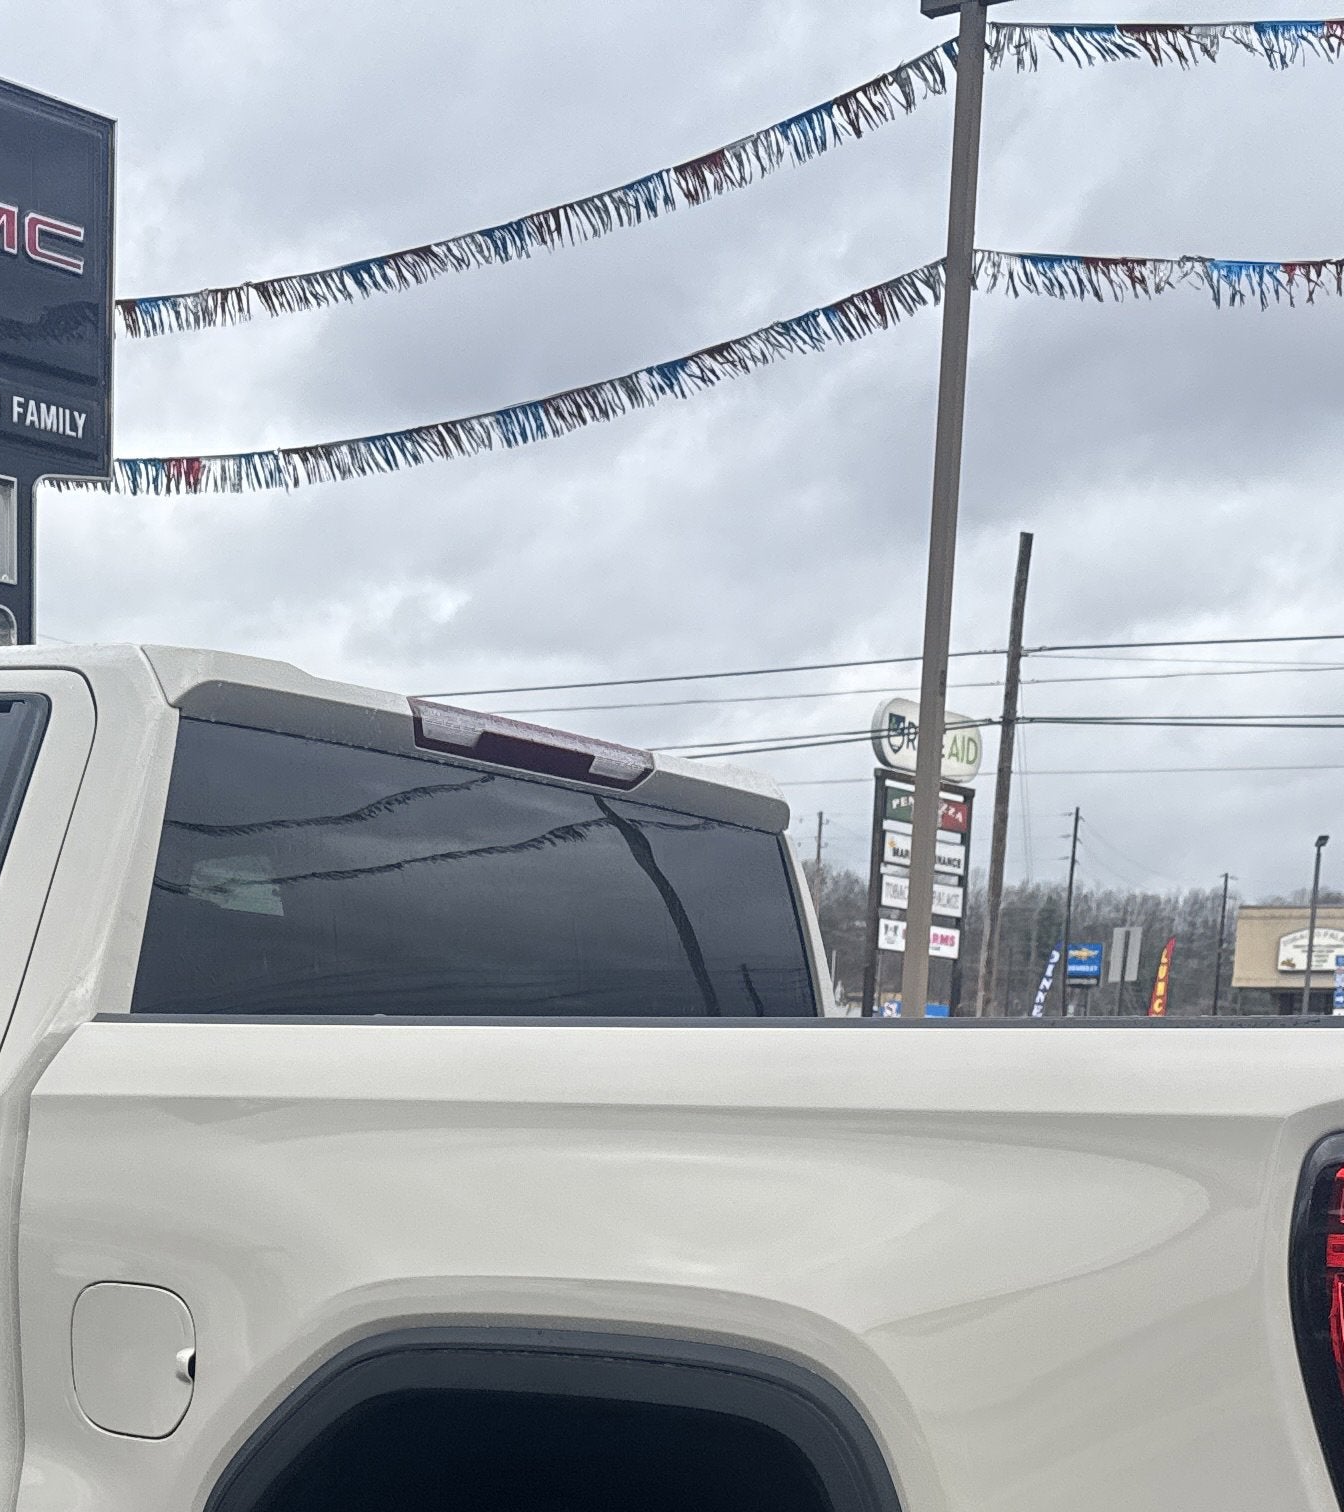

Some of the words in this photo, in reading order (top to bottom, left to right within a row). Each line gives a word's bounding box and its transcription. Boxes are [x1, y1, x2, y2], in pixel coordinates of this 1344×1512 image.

[12, 395, 87, 440] FAMILY
[947, 733, 979, 765] AID
[892, 796, 915, 809] PEN
[937, 856, 961, 869] NANCE
[1032, 949, 1061, 1017] DINNE
[1152, 947, 1169, 1017] LUNC
